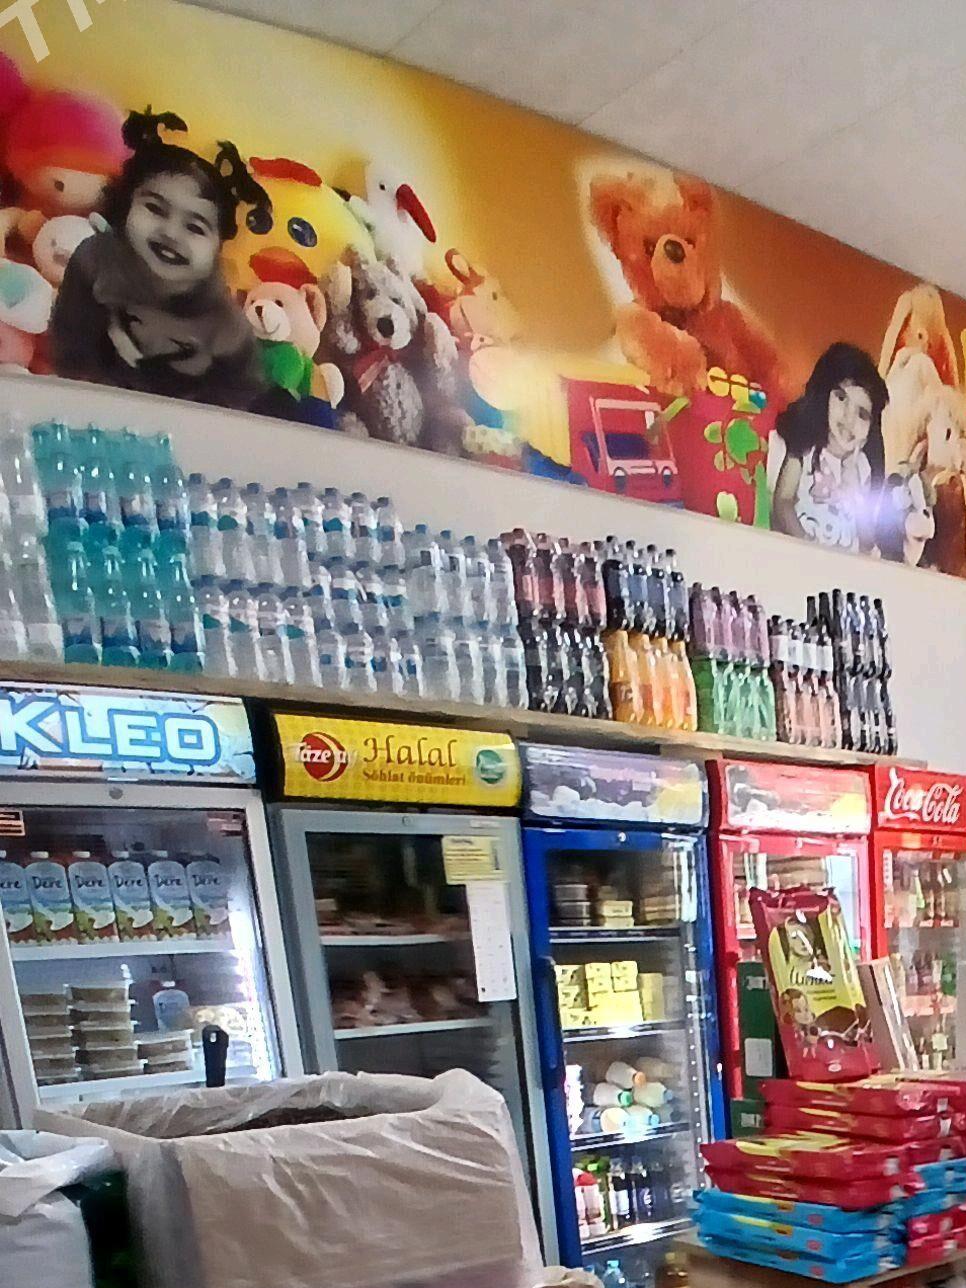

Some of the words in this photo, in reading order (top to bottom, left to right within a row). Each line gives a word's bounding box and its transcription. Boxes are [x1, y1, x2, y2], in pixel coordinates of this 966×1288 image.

[0, 697, 219, 764] KLEO
[363, 735, 457, 767] Halal
[0, 879, 22, 889] ere
[31, 876, 63, 889] Dere
[74, 875, 104, 888] Dere
[113, 875, 144, 887] Dere
[154, 874, 184, 887] Dere
[191, 873, 221, 886] Dere
